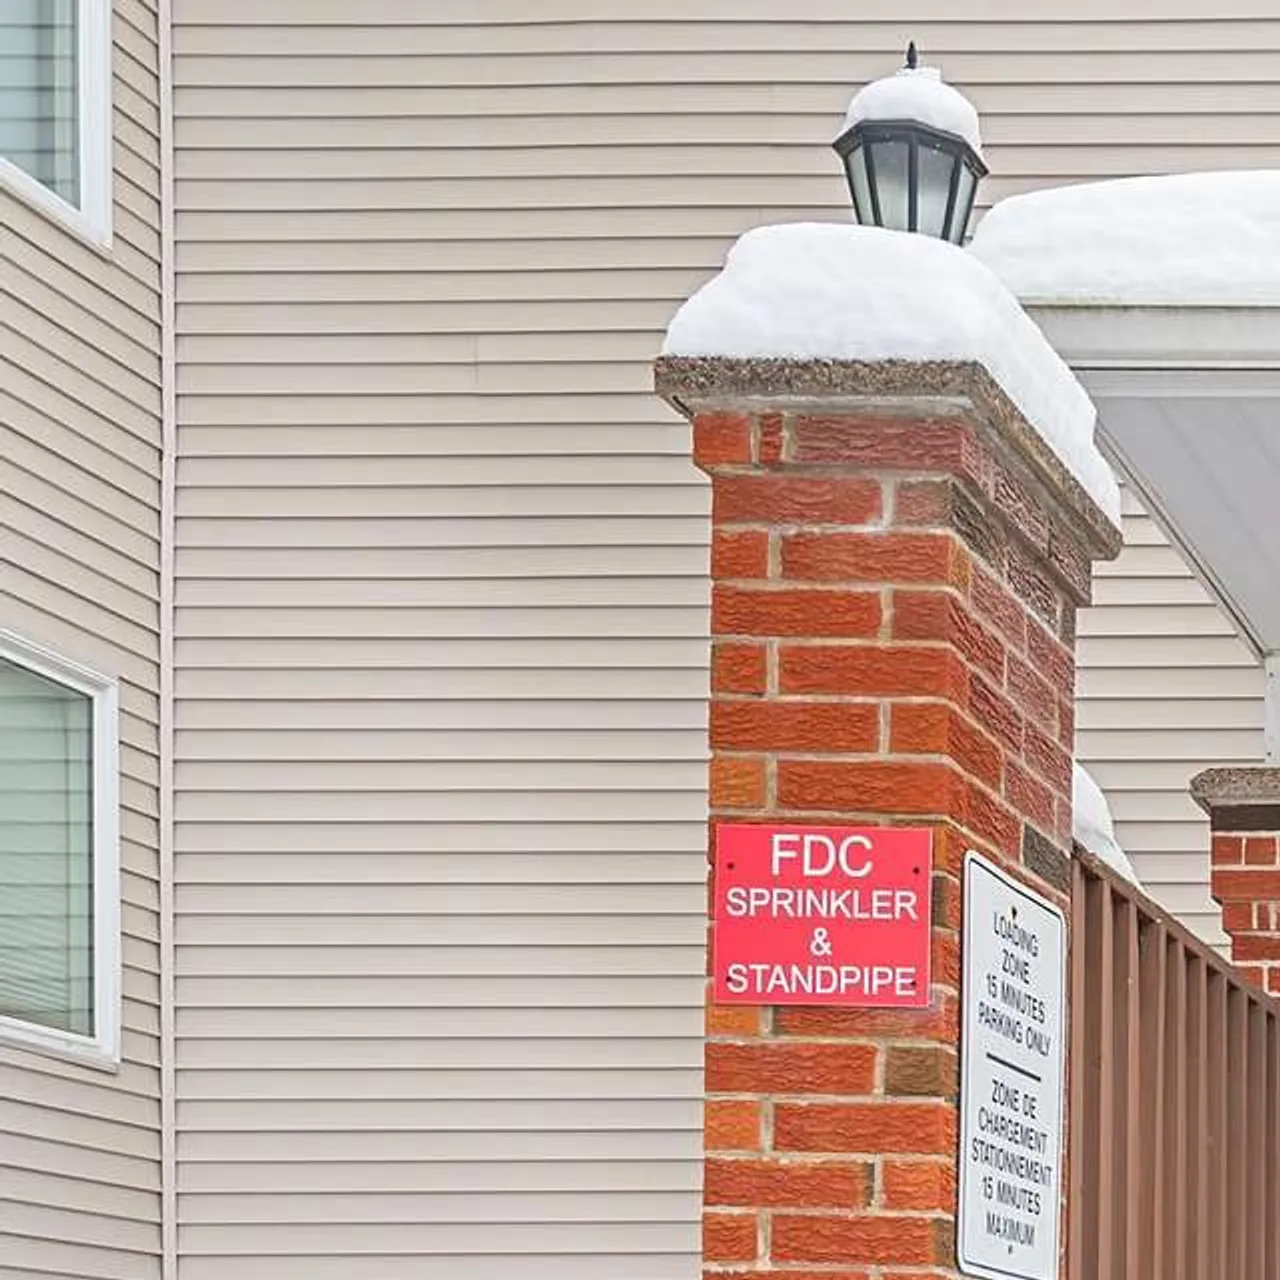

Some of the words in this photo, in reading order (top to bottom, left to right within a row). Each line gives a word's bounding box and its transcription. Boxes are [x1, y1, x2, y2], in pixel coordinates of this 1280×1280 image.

[772, 834, 873, 877] FDC
[726, 887, 918, 920] SPRINKLER
[810, 927, 832, 956] &
[993, 912, 1039, 957] LOADING
[726, 963, 916, 995] STANDPIPE
[1001, 949, 1030, 985] ZONE
[986, 973, 997, 999] 15
[1001, 980, 1045, 1024] MINUTES
[978, 1001, 1023, 1044] PARKING
[1026, 1026, 1051, 1056] ONLY
[991, 1078, 1019, 1112] ZONE
[1023, 1093, 1037, 1119] DE
[978, 1106, 1047, 1155] CHARGEMENT
[972, 1137, 1053, 1187] STATIONNEMENT
[982, 1175, 993, 1200] 15
[997, 1180, 1041, 1215] MINUTES
[986, 1209, 1035, 1247] MAXIMUM
